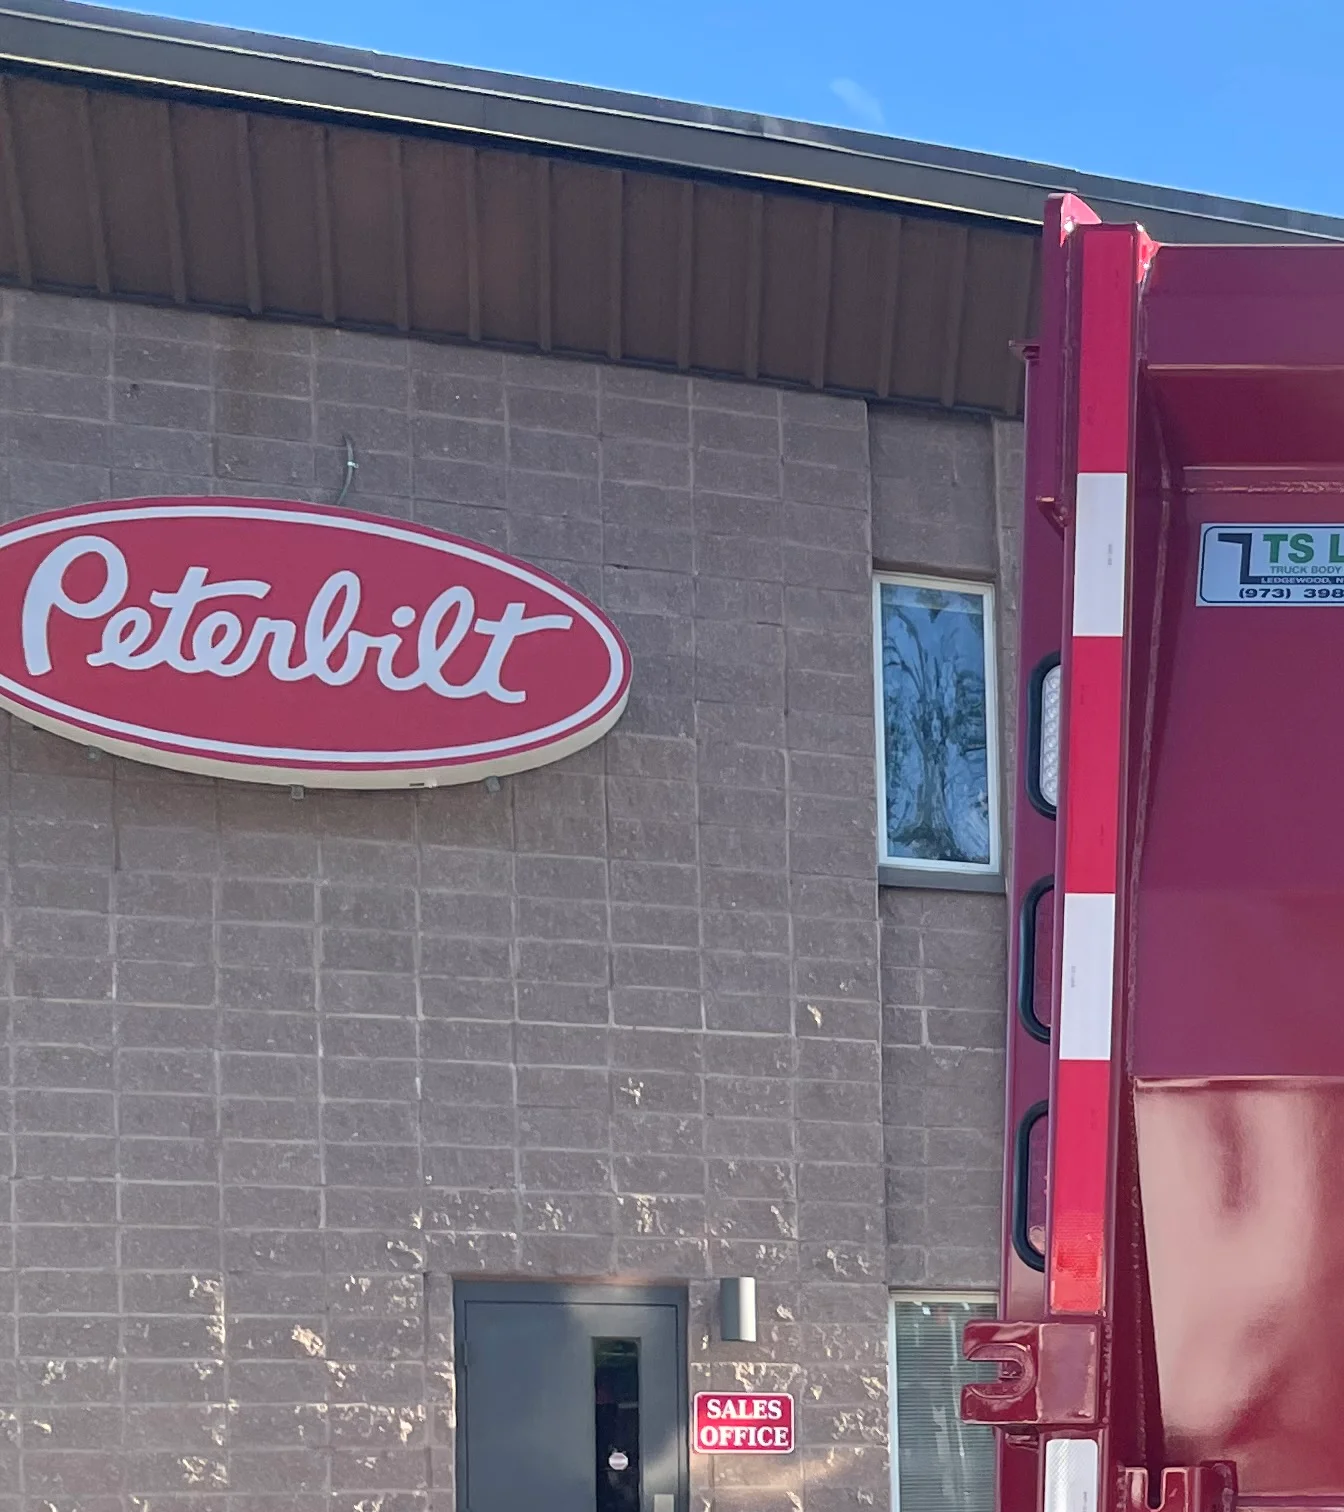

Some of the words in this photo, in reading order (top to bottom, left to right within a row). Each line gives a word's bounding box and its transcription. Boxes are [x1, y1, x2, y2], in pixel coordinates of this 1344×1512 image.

[1263, 533, 1314, 564] TS
[1270, 565, 1307, 575] TRUCK
[1310, 565, 1342, 575] BODY
[1239, 588, 1292, 599] (973)
[22, 535, 574, 704] Peterbilt
[706, 1398, 782, 1420] SALES
[700, 1425, 789, 1447] OFFICE
